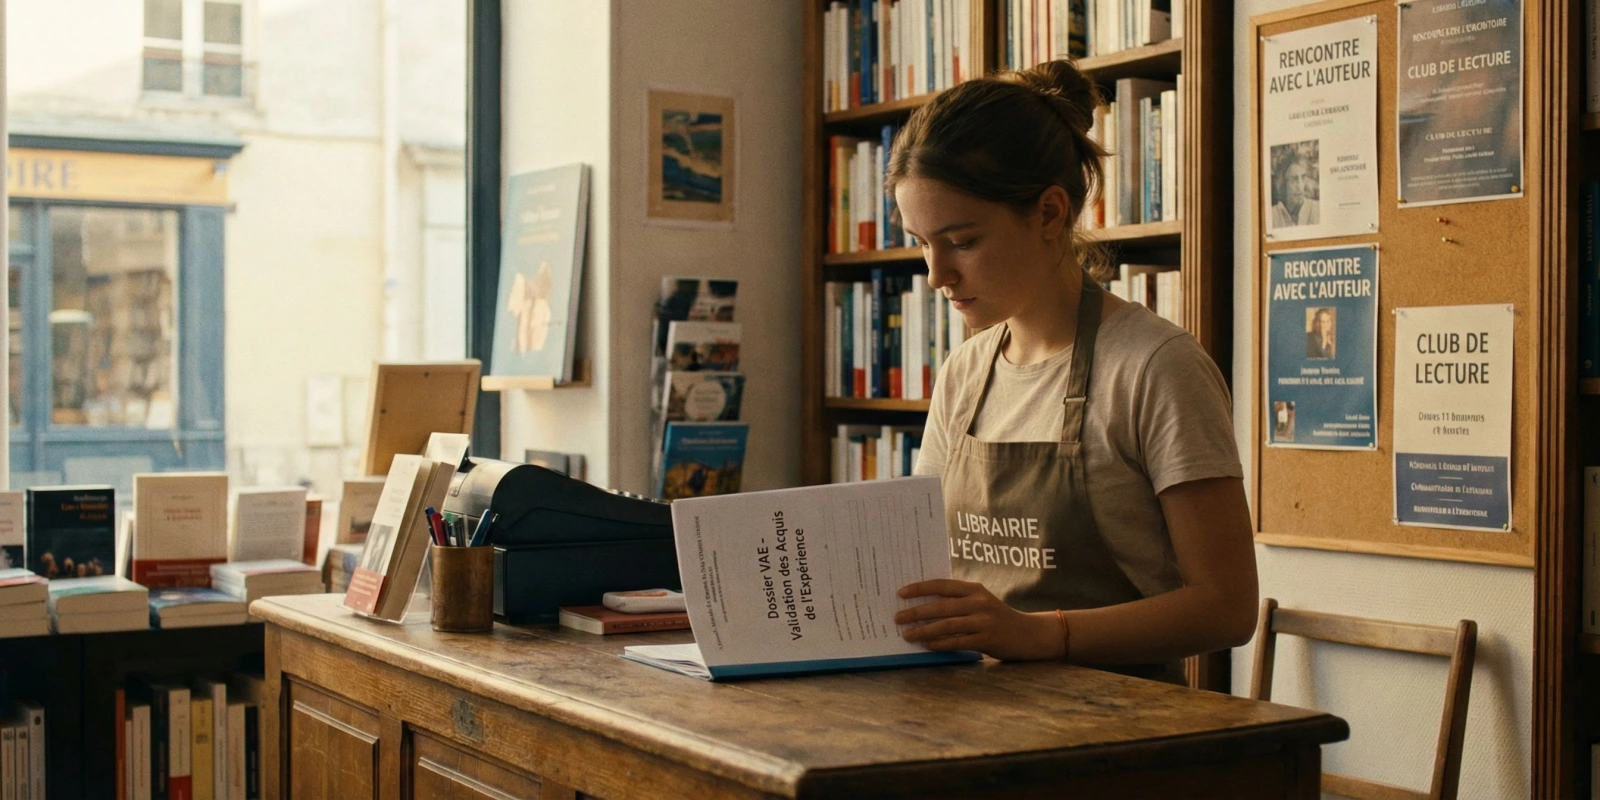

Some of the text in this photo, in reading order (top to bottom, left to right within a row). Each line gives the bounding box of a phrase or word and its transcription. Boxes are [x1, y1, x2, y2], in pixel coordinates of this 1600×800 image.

[1279, 37, 1360, 70] RENCONTRE
[1407, 49, 1511, 80] CLUB DE LECTURE
[1269, 60, 1371, 94] AVEC L'AUTEUR
[8, 158, 79, 190] IRE
[1284, 256, 1362, 279] RENCONTRE
[1273, 279, 1371, 301] AVEC L'AUTEUR
[1416, 331, 1489, 355] CLUB DE
[1415, 362, 1490, 385] LECTURE
[957, 510, 1040, 540] LIBRAIRIE
[757, 546, 771, 573] VAE
[949, 534, 1057, 570] L'ÉCRITOIRE
[773, 510, 803, 641] Validation des Acquis
[795, 528, 816, 621] de l'Expérience
[763, 575, 779, 619] Dossier
